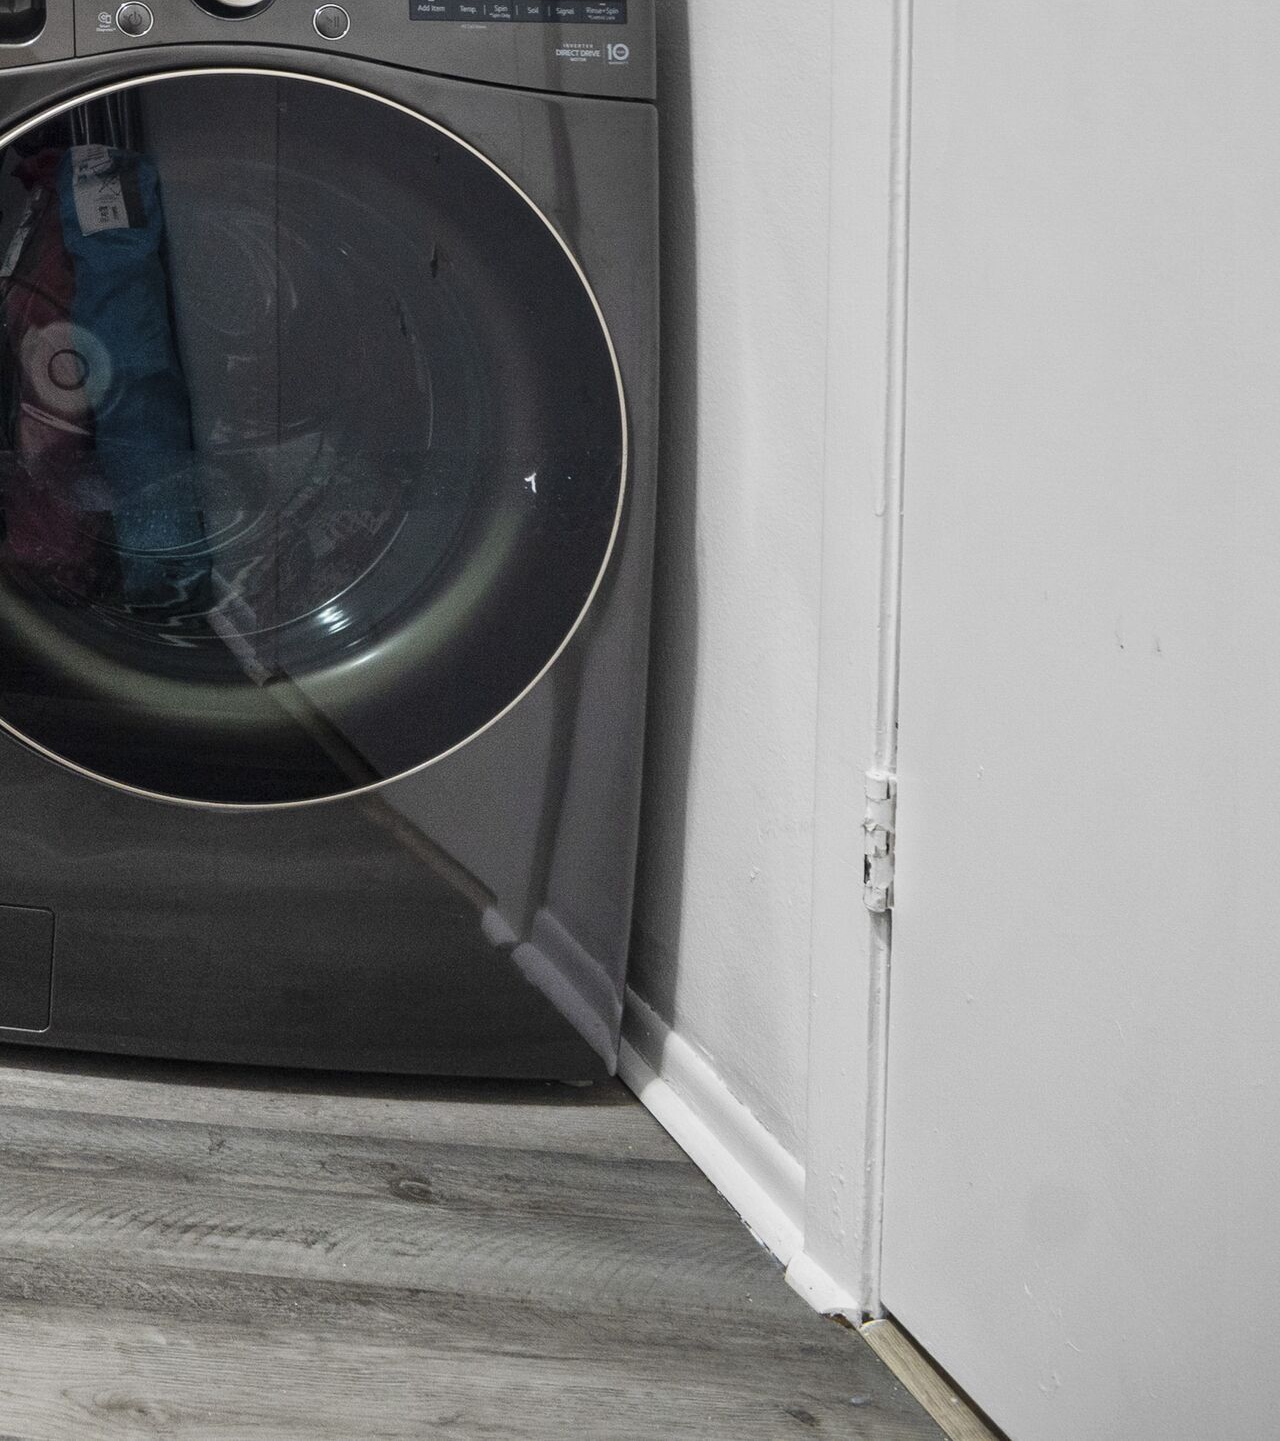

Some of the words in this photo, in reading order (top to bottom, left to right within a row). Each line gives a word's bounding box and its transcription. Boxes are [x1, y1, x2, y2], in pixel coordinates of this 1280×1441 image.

[494, 5, 508, 13] Spin
[527, 6, 539, 14] Soil
[556, 7, 575, 16] Signal
[580, 49, 601, 57] DRIVE
[607, 43, 629, 61] 10
